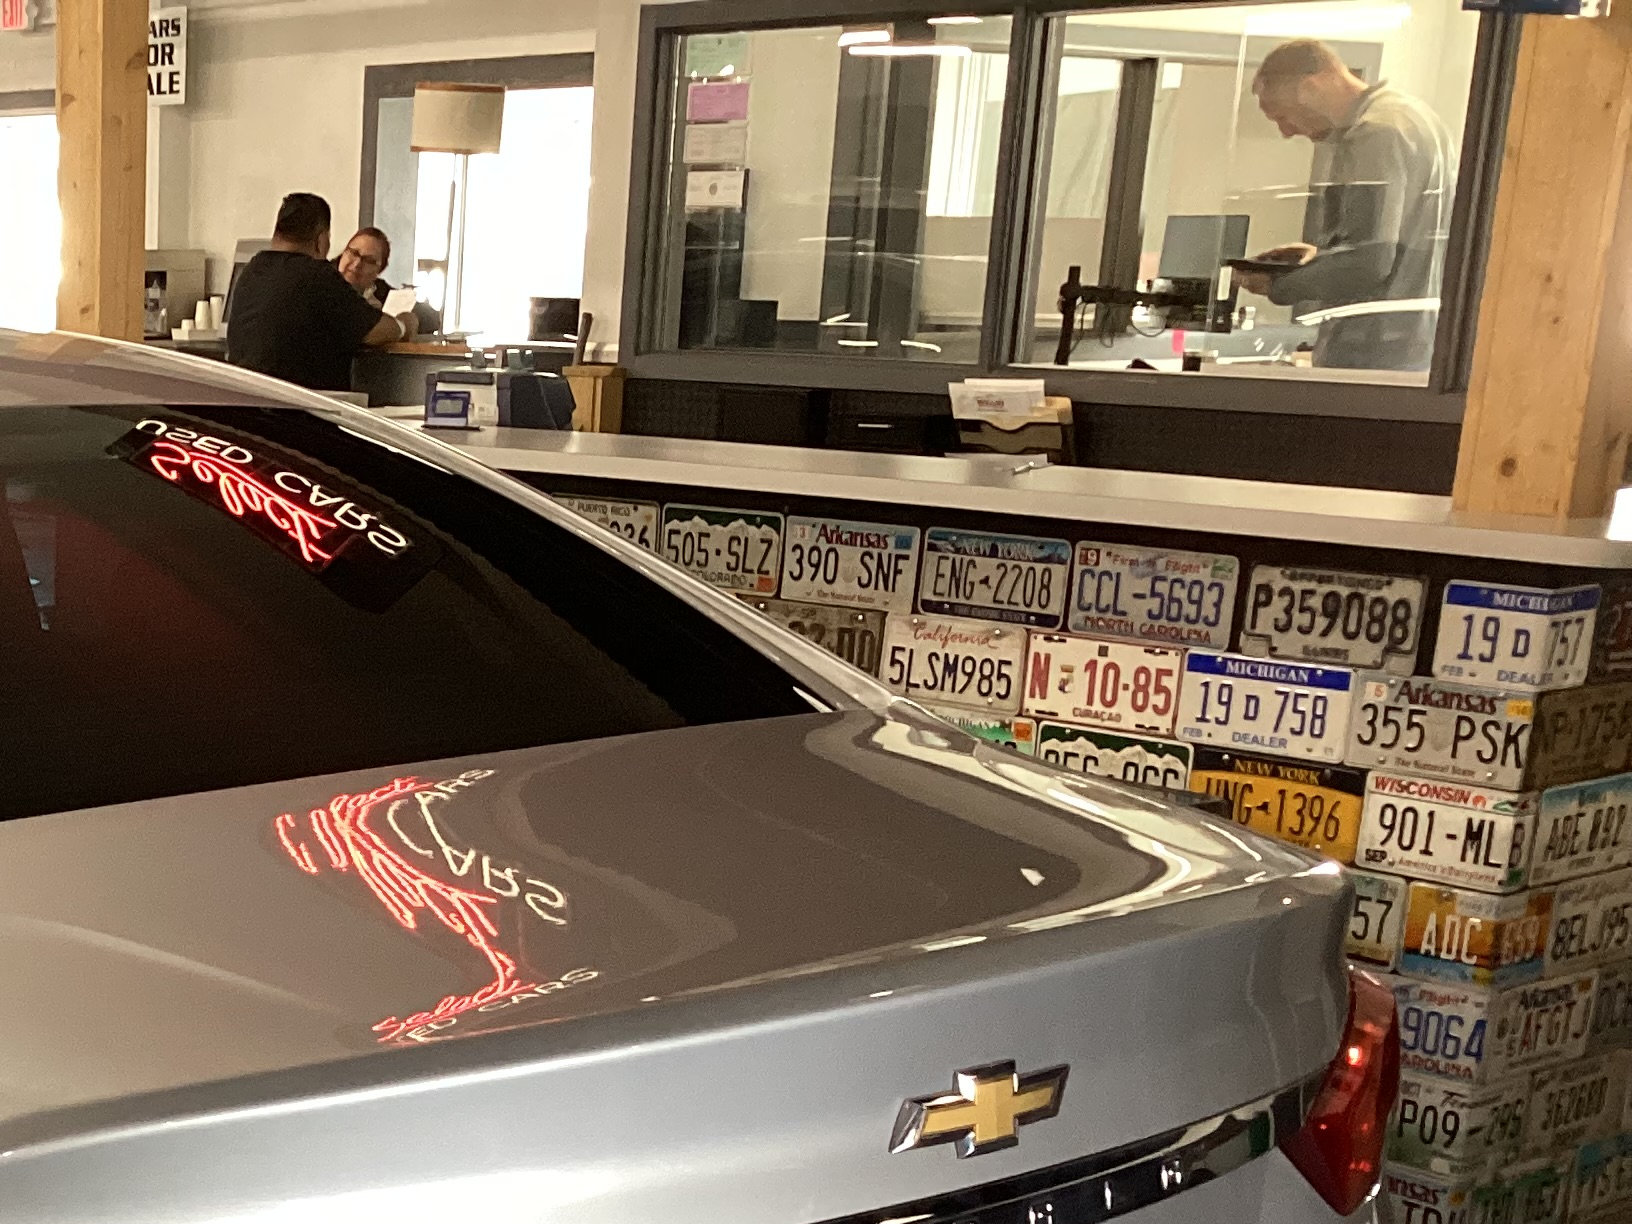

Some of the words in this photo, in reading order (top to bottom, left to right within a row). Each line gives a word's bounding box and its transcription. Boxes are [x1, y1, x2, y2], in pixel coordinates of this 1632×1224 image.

[149, 18, 181, 38] ARS
[147, 43, 174, 67] OR
[147, 71, 180, 96] ALE
[816, 523, 890, 550] Arkansas
[788, 543, 840, 585] 390
[857, 550, 910, 593] SNF
[1077, 568, 1225, 628] CCL-5693
[1251, 583, 1412, 645] P359088
[913, 621, 1000, 650] California
[1456, 613, 1500, 663] 19
[1511, 628, 1531, 658] D
[888, 645, 1013, 700] 5LSM985
[1029, 651, 1052, 700] N
[1225, 659, 1310, 684] MICHIGAN
[1194, 679, 1234, 726] 19
[1243, 694, 1260, 721] D
[1272, 688, 1329, 739] 758
[1393, 679, 1498, 715] Arkansas
[1231, 731, 1288, 750] DEALER
[1356, 702, 1428, 753] 355
[1450, 714, 1530, 769] PSK
[1234, 758, 1273, 777] NEW
[1277, 764, 1321, 786] YORK
[1374, 775, 1472, 804] WISCONSIN
[1400, 1006, 1487, 1063] 9064
